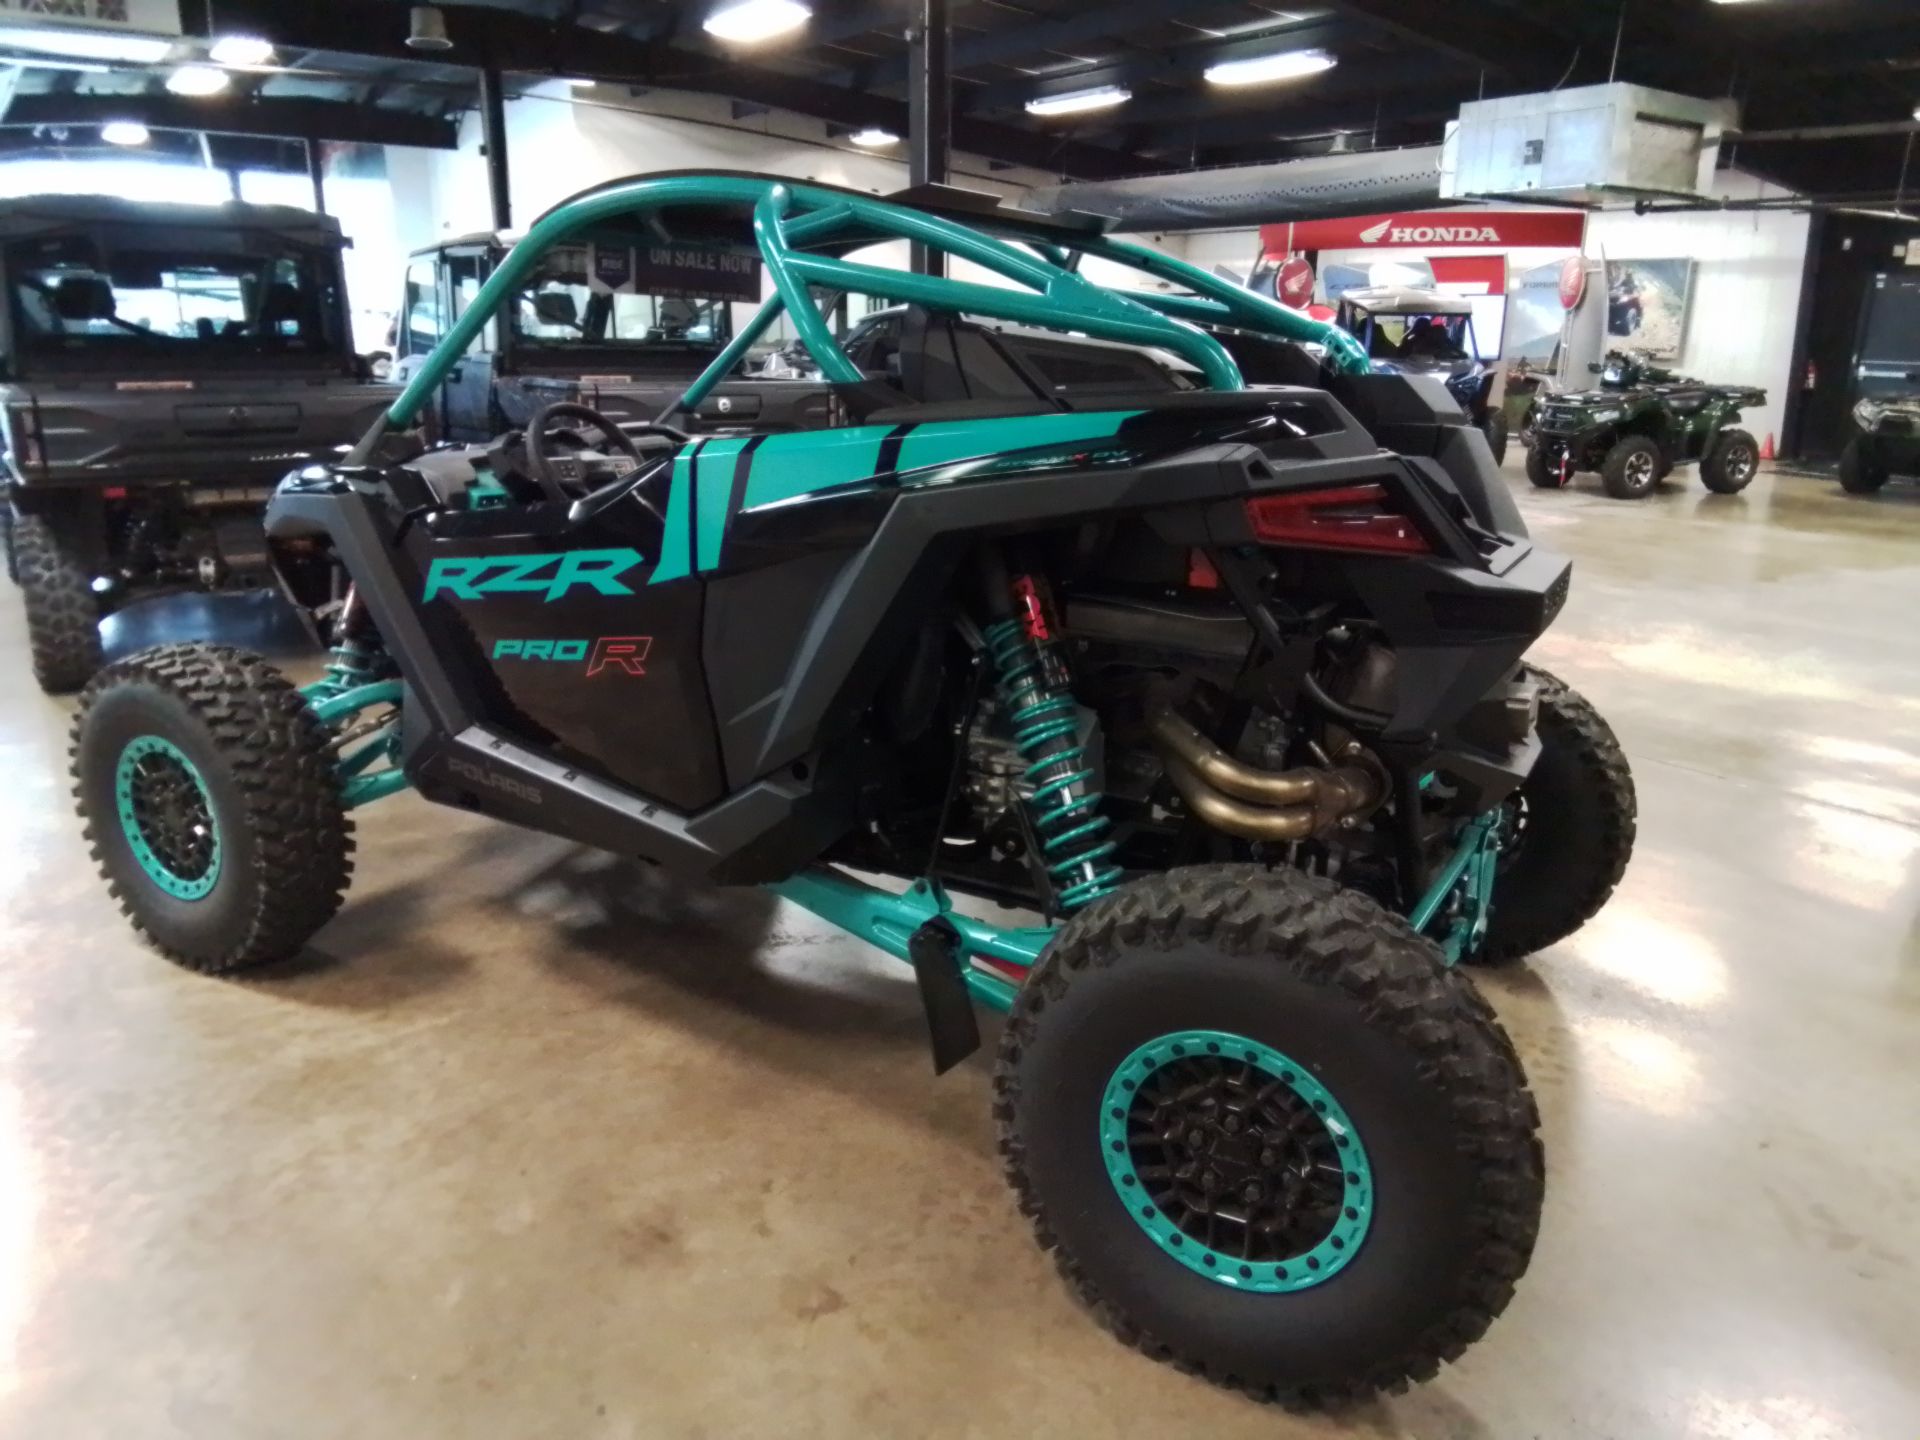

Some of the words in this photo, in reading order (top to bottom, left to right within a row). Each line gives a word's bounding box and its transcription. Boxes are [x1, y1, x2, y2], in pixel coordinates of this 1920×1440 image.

[1390, 226, 1500, 243] HONDA
[674, 251, 718, 271] SALE
[720, 253, 753, 274] NOW
[422, 547, 644, 604] RZR
[492, 639, 588, 661] PRO
[586, 636, 653, 677] R
[447, 756, 543, 805] POLARIS
